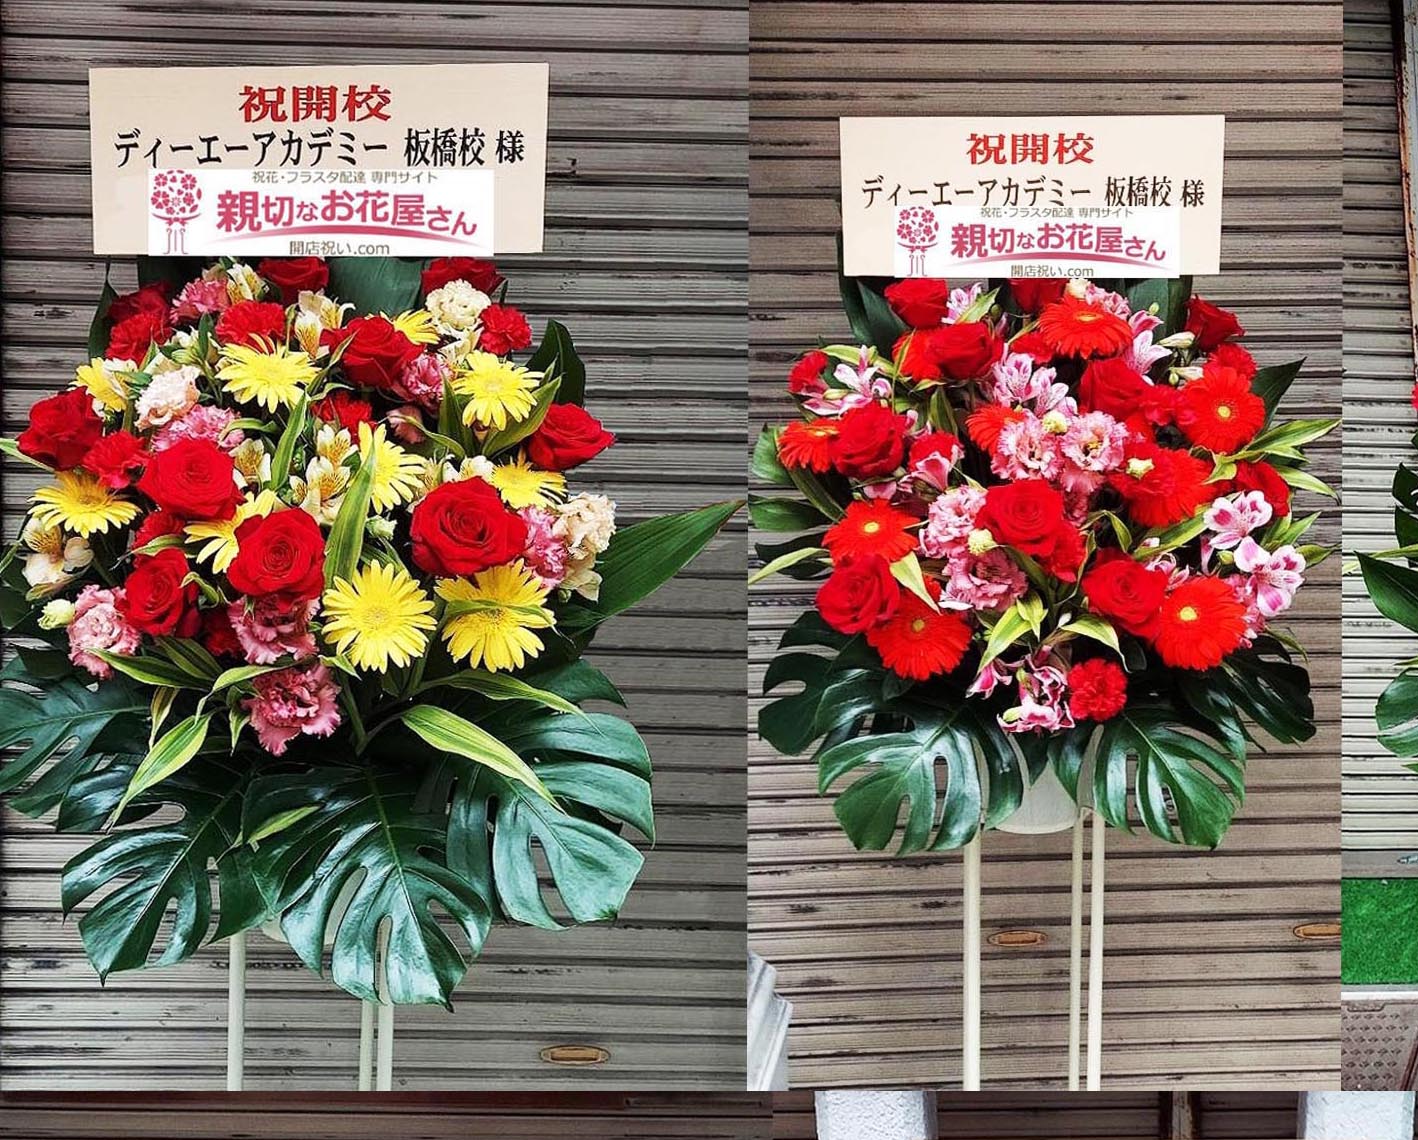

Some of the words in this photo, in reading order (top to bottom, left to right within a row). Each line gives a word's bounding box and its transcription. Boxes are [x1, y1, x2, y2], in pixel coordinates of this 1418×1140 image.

[240, 85, 390, 123] 祝開校
[115, 127, 387, 168] ディーエーアカデミー
[404, 128, 485, 166] 板橋校
[496, 130, 524, 163] 様
[966, 133, 1093, 165] 祝開校
[863, 176, 1090, 208] ディーエーアカデミー
[1106, 176, 1171, 206] 板橋校
[1181, 180, 1204, 207] 様
